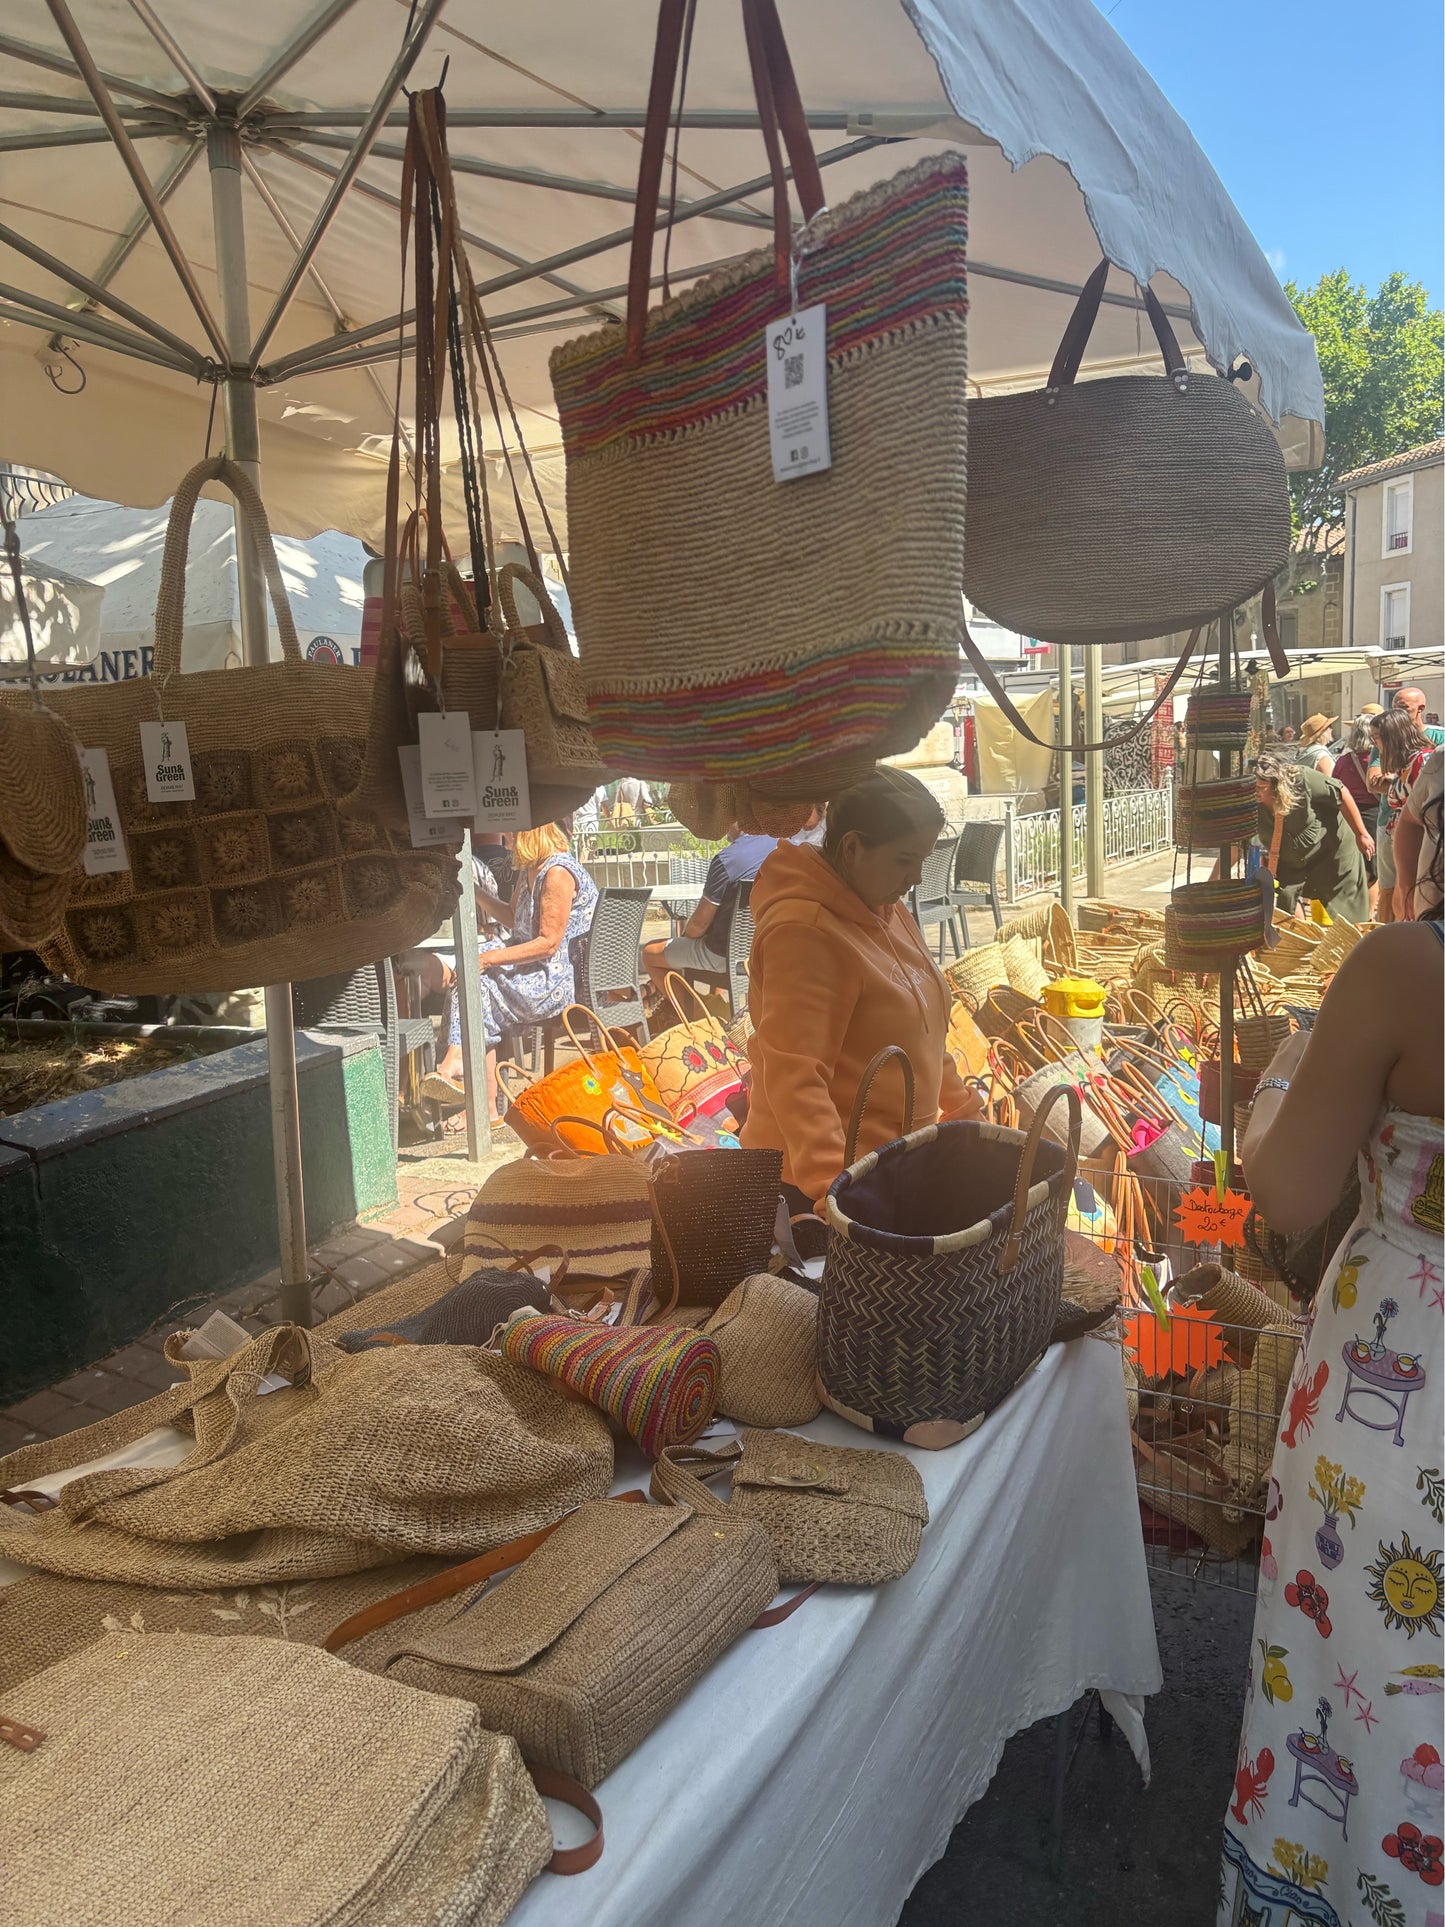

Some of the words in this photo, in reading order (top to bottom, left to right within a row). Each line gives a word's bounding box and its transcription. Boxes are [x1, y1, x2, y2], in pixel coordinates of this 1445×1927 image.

[307, 639, 341, 657] PAULANER
[5, 646, 155, 684] ANER
[157, 764, 184, 775] Sun&
[156, 772, 185, 782] Green
[485, 786, 518, 798] Sun&
[482, 795, 519, 808] Green
